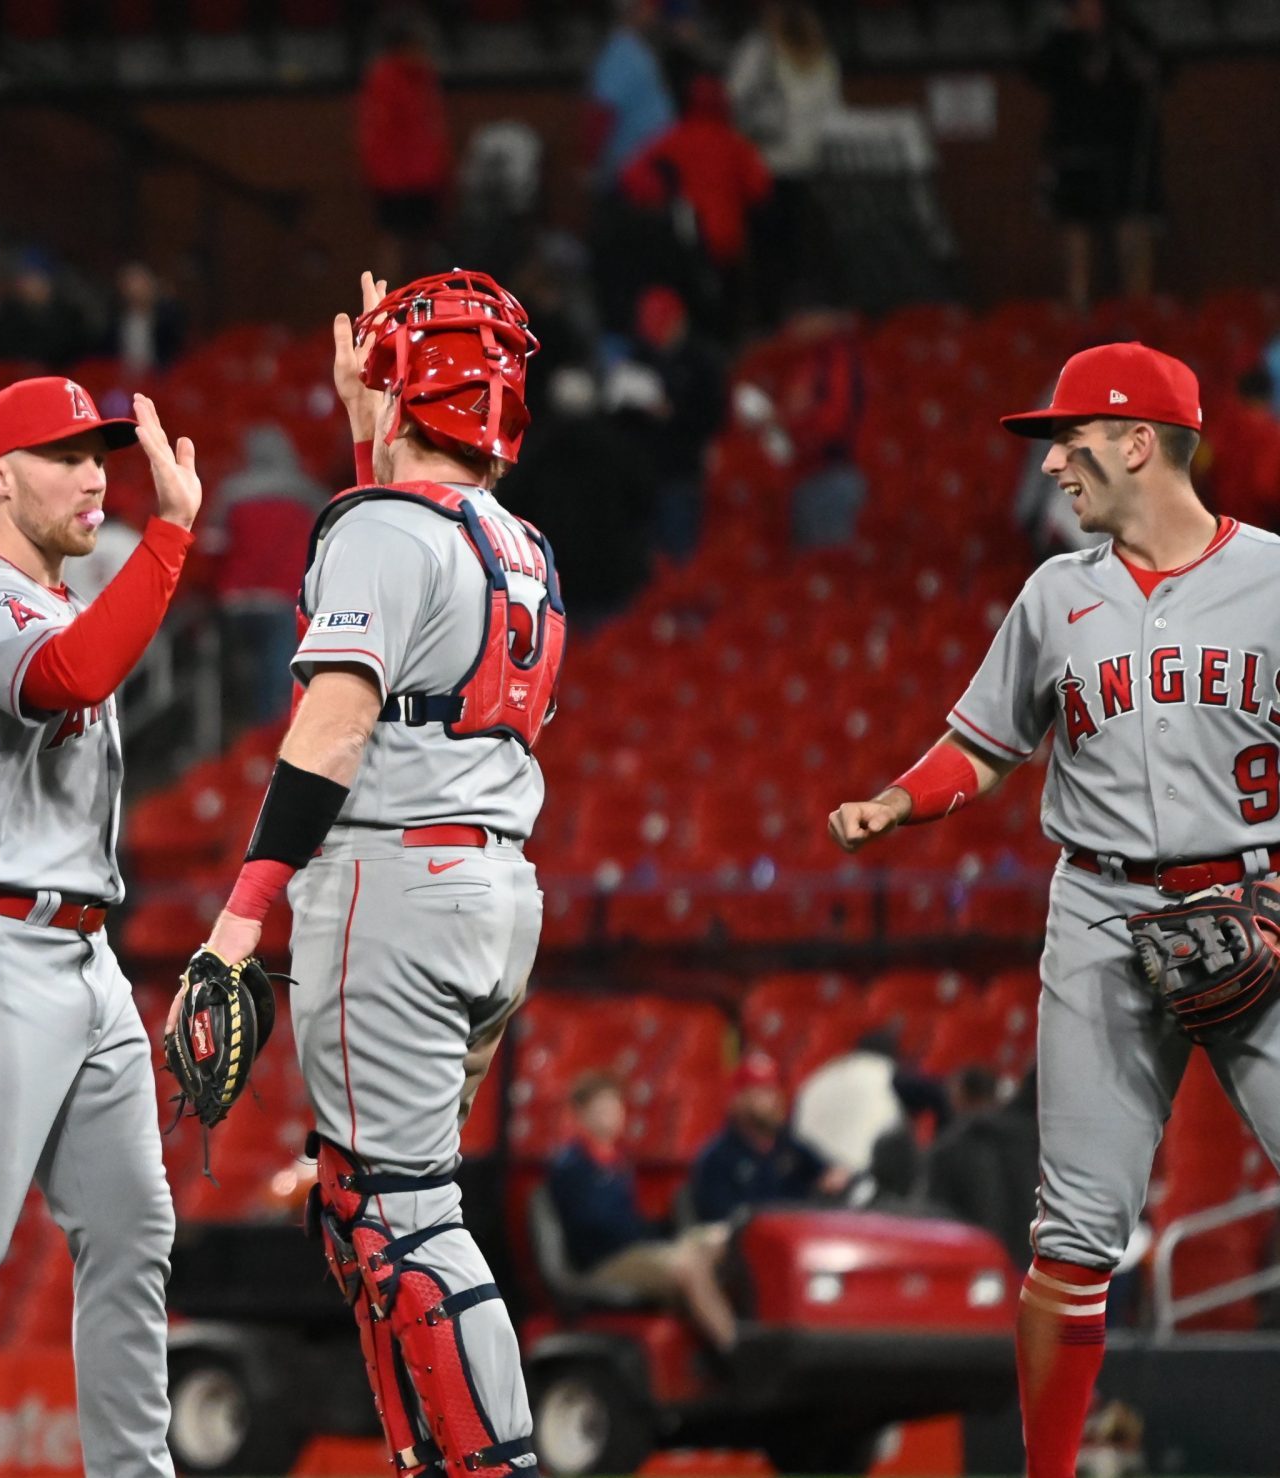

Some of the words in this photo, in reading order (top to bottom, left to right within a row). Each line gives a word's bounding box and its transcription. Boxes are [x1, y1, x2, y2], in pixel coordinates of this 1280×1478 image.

[478, 515, 548, 585] ALLA
[331, 613, 364, 625] FBM
[1232, 743, 1280, 826] 9
